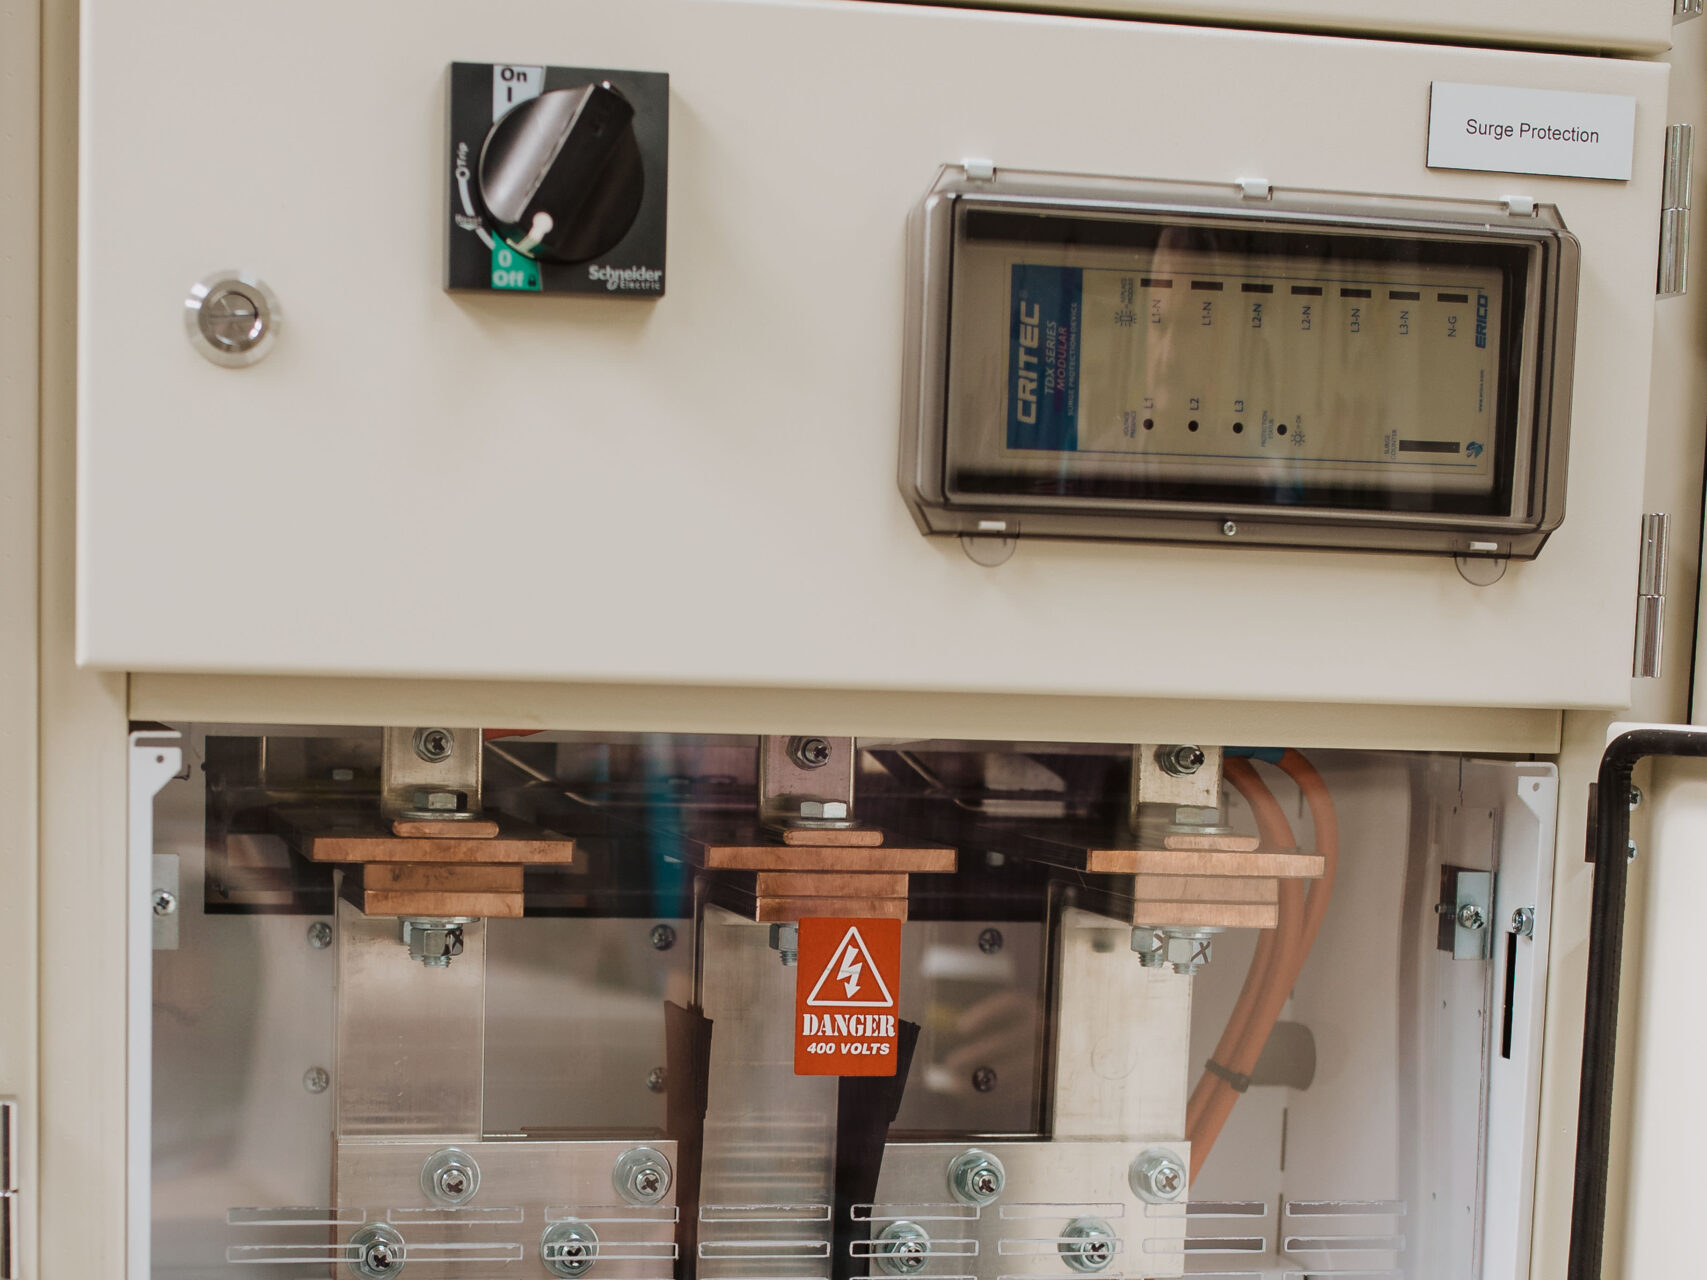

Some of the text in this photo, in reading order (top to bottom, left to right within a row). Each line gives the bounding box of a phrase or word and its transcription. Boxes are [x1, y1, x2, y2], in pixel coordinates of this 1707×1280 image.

[501, 67, 528, 83] On
[507, 87, 513, 103] I
[1466, 118, 1600, 144] Surge Protection
[456, 142, 469, 166] Trip
[493, 270, 525, 288] Off
[589, 264, 662, 284] Schneider
[619, 280, 661, 291] Electric
[1151, 299, 1162, 324] L1-N
[1201, 301, 1212, 327] L1-N
[1252, 303, 1262, 329] L2-N
[1301, 305, 1312, 331] L2-N
[1351, 308, 1361, 333] L3-N
[1400, 310, 1410, 335] L3-N
[1475, 294, 1489, 349] ERICO
[1448, 315, 1458, 338] N-G
[1017, 301, 1040, 425] CRITEC
[1044, 320, 1057, 395] TDX SERIES
[1056, 326, 1068, 392] MODULAR
[1068, 333, 1077, 388] PROTECTION
[1144, 397, 1154, 409] L1
[1189, 398, 1200, 411] L2
[1234, 399, 1244, 412] L3
[802, 1013, 896, 1037] DANGER
[807, 1042, 890, 1055] 400 VOLTS
